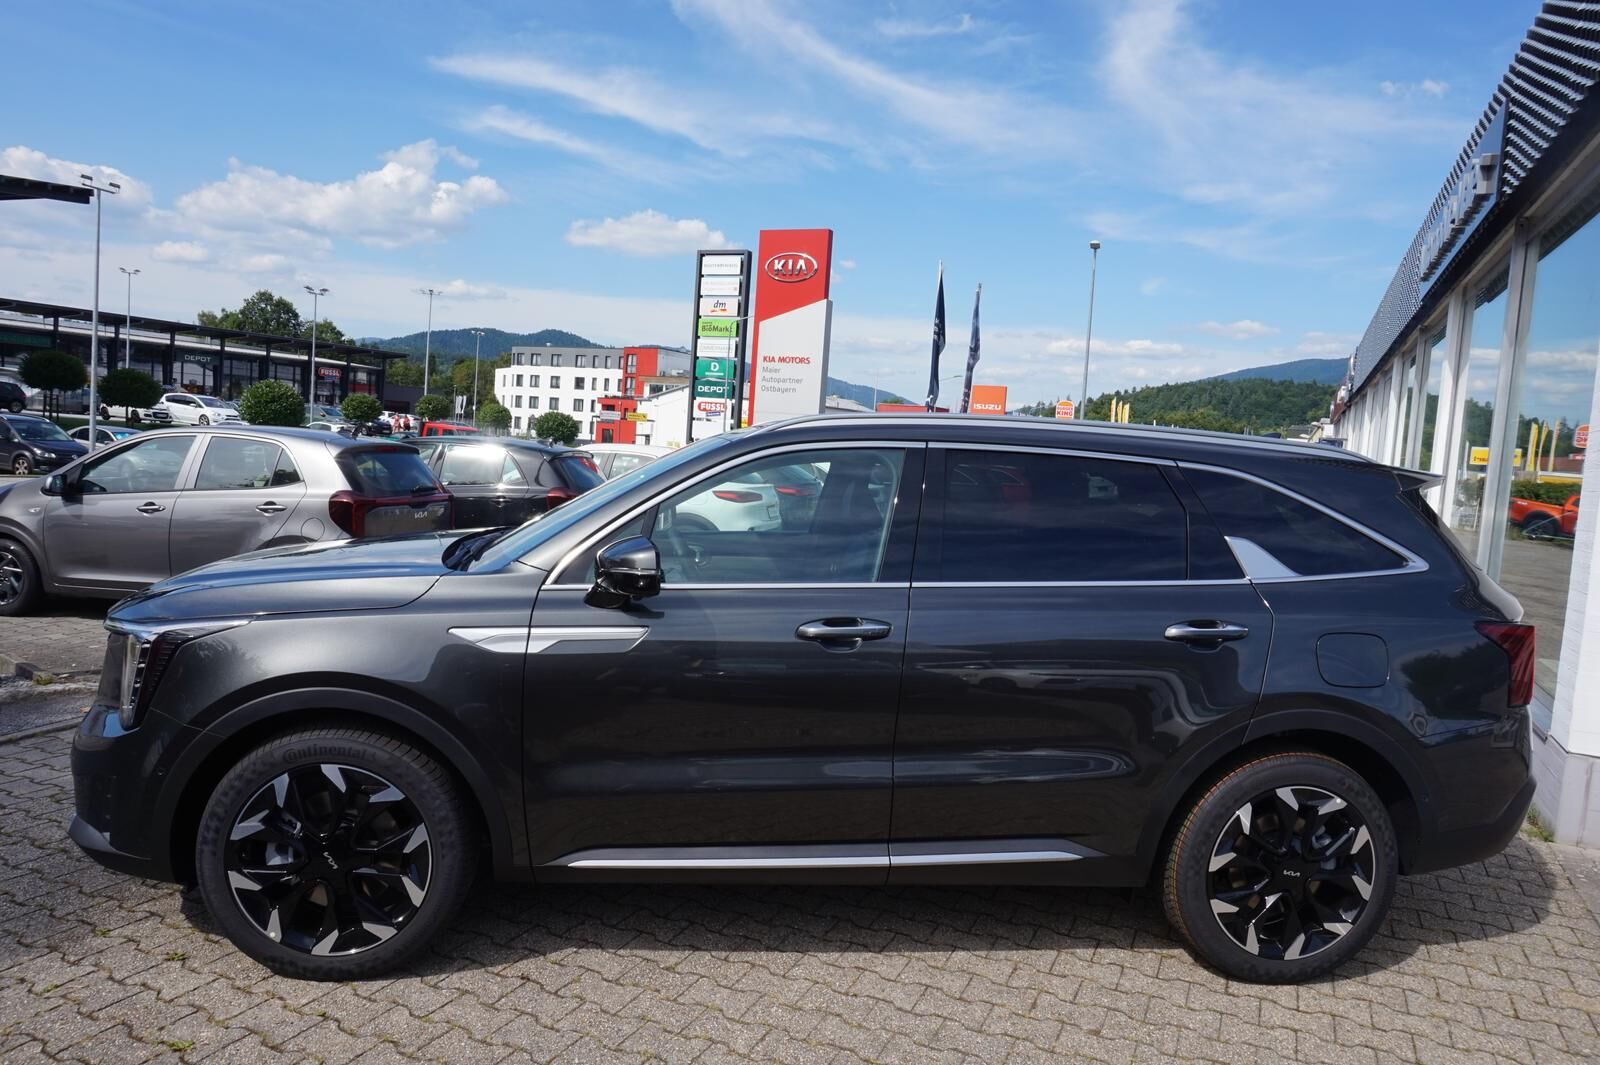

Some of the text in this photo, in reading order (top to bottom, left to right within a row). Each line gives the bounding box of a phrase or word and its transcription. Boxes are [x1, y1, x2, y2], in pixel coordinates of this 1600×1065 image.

[773, 259, 808, 276] KIA
[713, 300, 726, 308] dm
[184, 354, 211, 362] DEPOT
[763, 355, 811, 364] KIA MOTORS
[710, 362, 719, 371] D
[762, 366, 781, 374] Maier
[761, 376, 803, 385] Autopartner
[761, 385, 797, 394] Ostbayern
[282, 743, 368, 762] Continental
